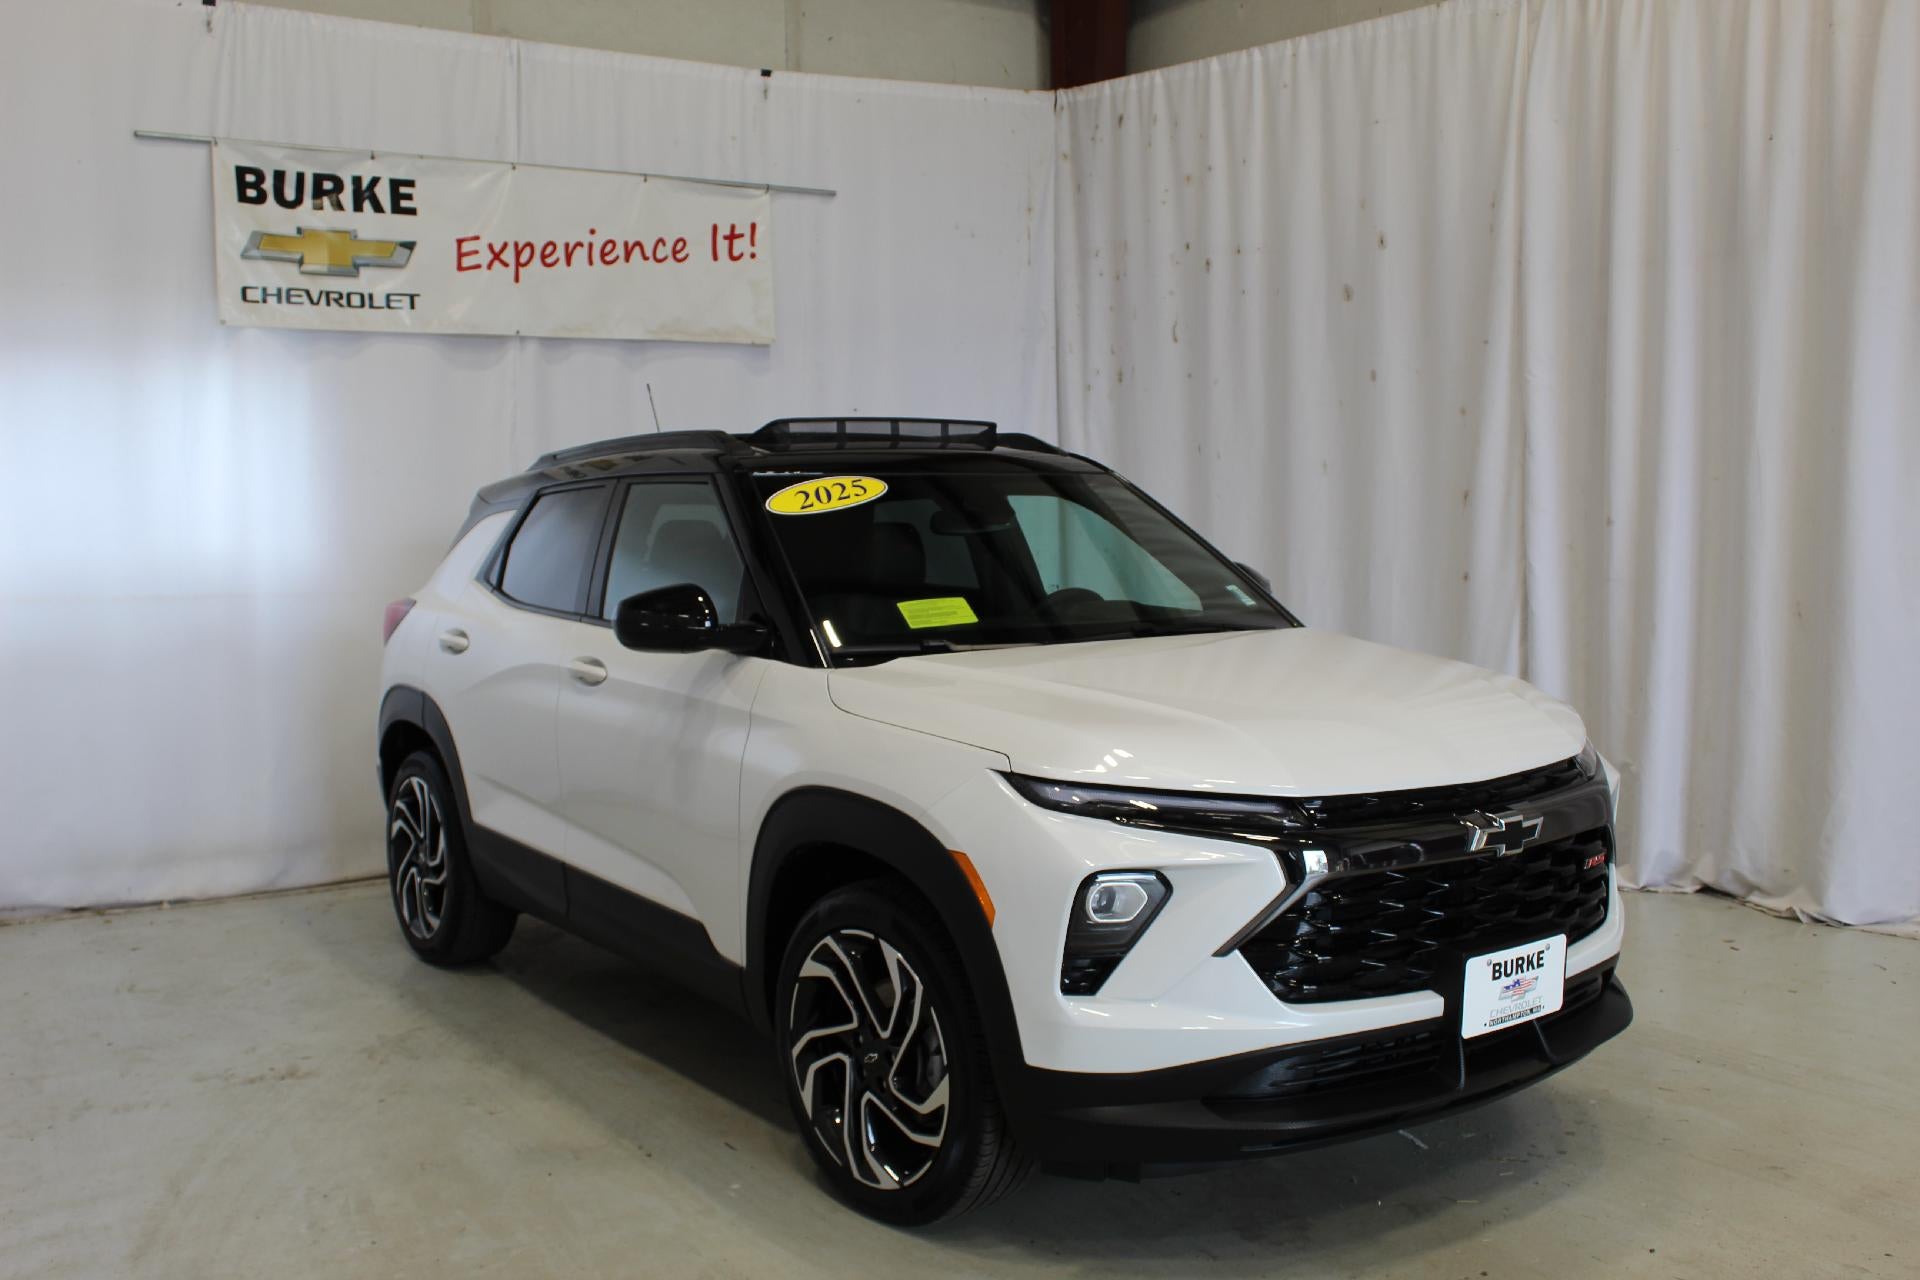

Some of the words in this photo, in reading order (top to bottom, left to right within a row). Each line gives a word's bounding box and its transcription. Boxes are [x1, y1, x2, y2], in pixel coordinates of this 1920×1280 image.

[235, 165, 417, 216] BURKE
[455, 228, 690, 283] Experience
[711, 222, 757, 261] It!
[241, 286, 420, 310] CHEVROLET
[794, 479, 867, 510] 2025
[1491, 950, 1545, 981] BURKE
[1490, 996, 1544, 1018] CHEVROLET
